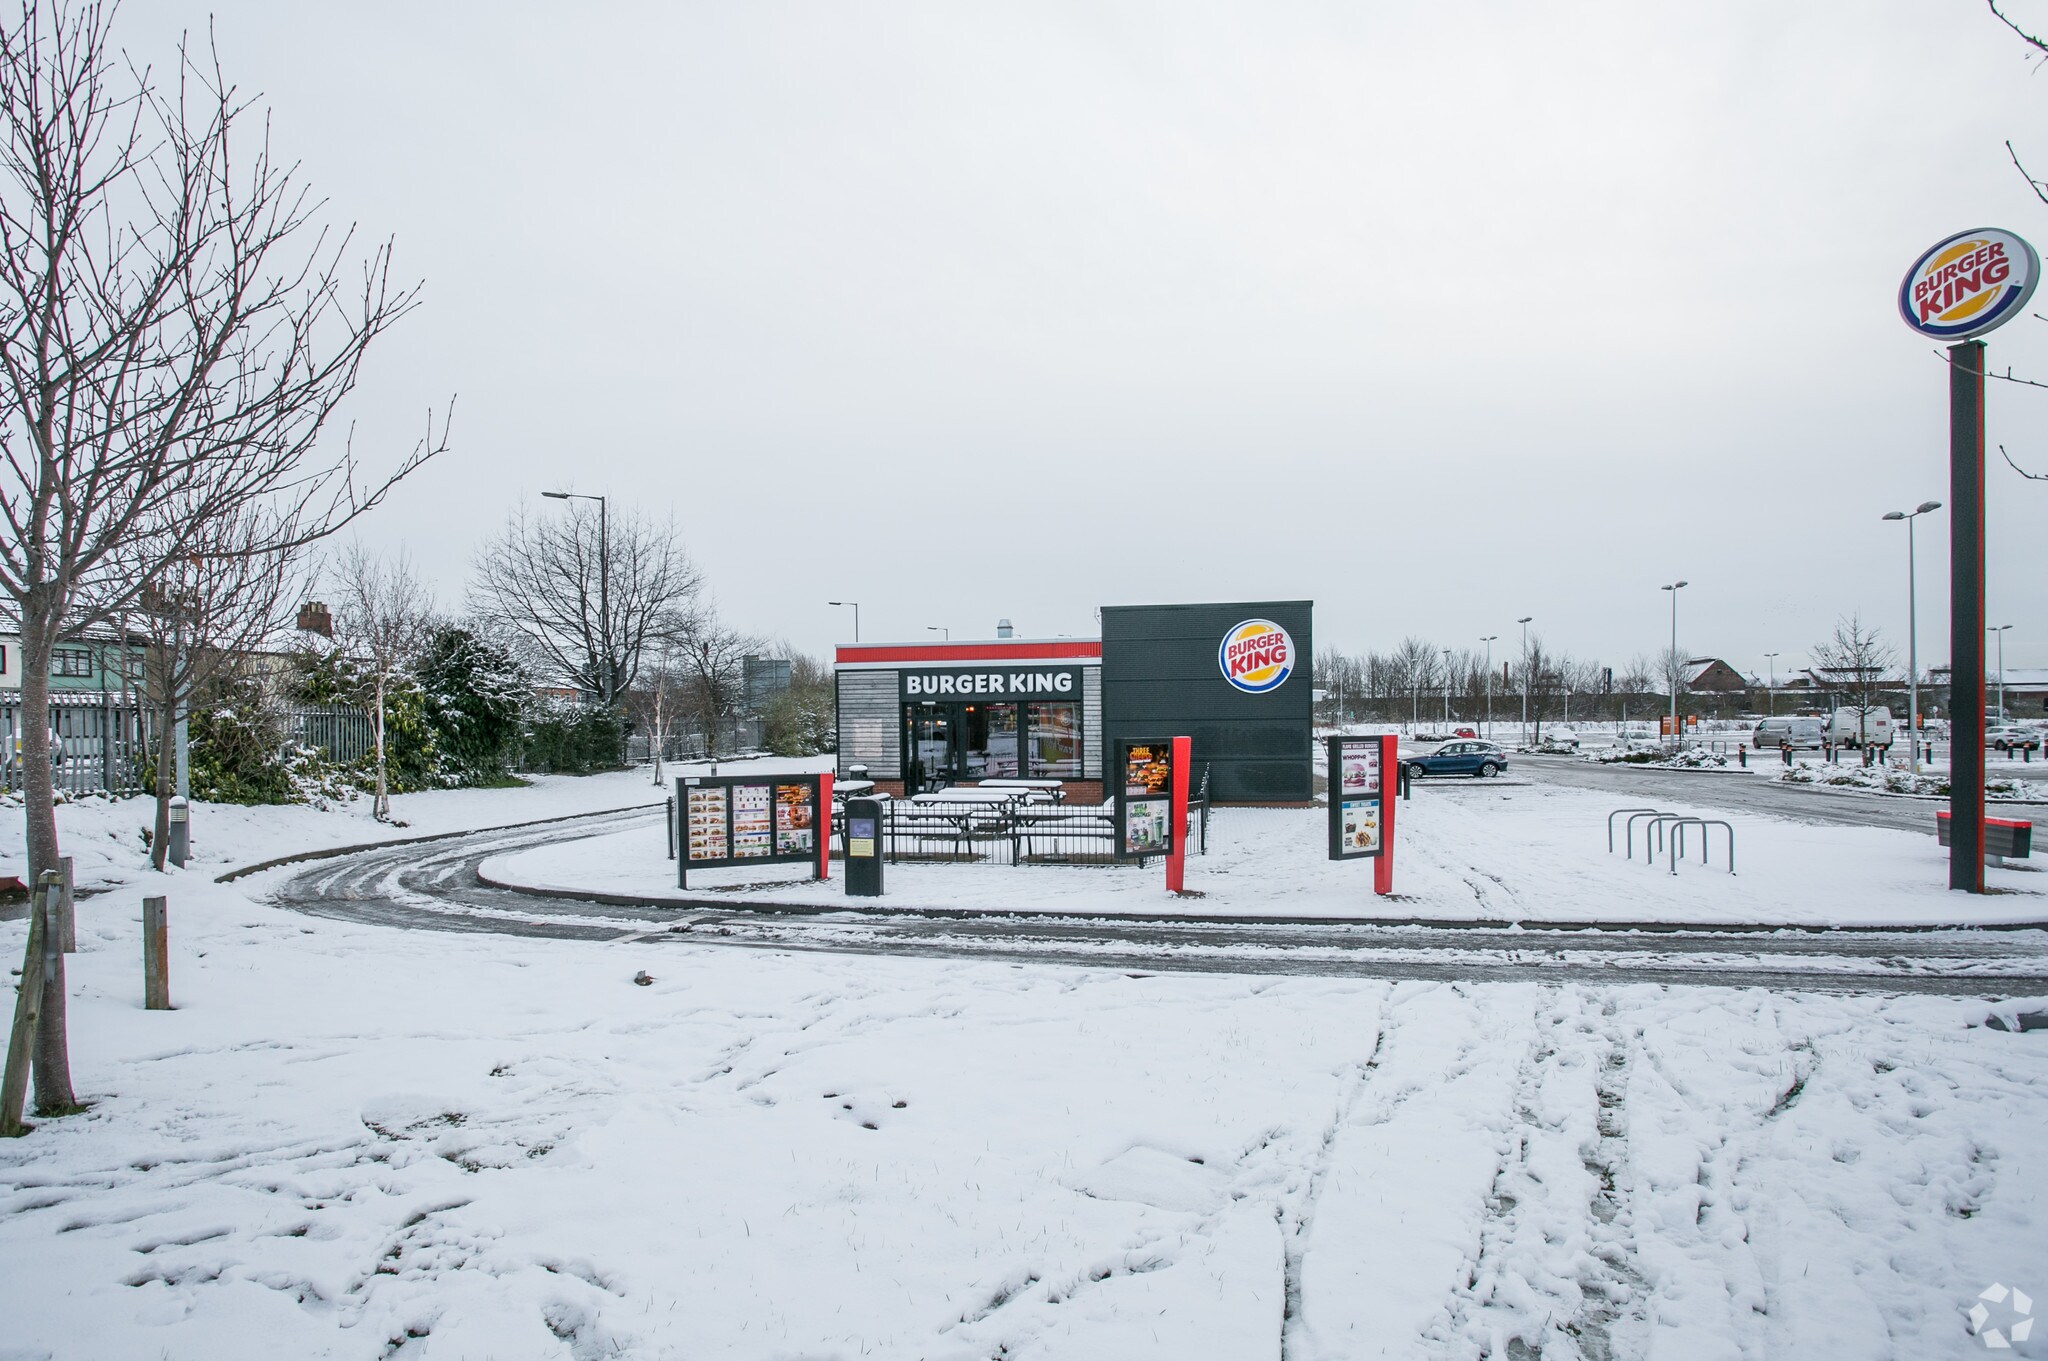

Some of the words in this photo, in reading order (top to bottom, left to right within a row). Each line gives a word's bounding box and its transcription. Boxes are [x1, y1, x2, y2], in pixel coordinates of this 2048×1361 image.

[1914, 242, 2004, 302] BURGER
[1920, 257, 2010, 324] KING
[1228, 632, 1284, 660] BURGER
[1231, 645, 1287, 678] KING
[906, 674, 1005, 695] BURGER
[1009, 672, 1073, 693] KING
